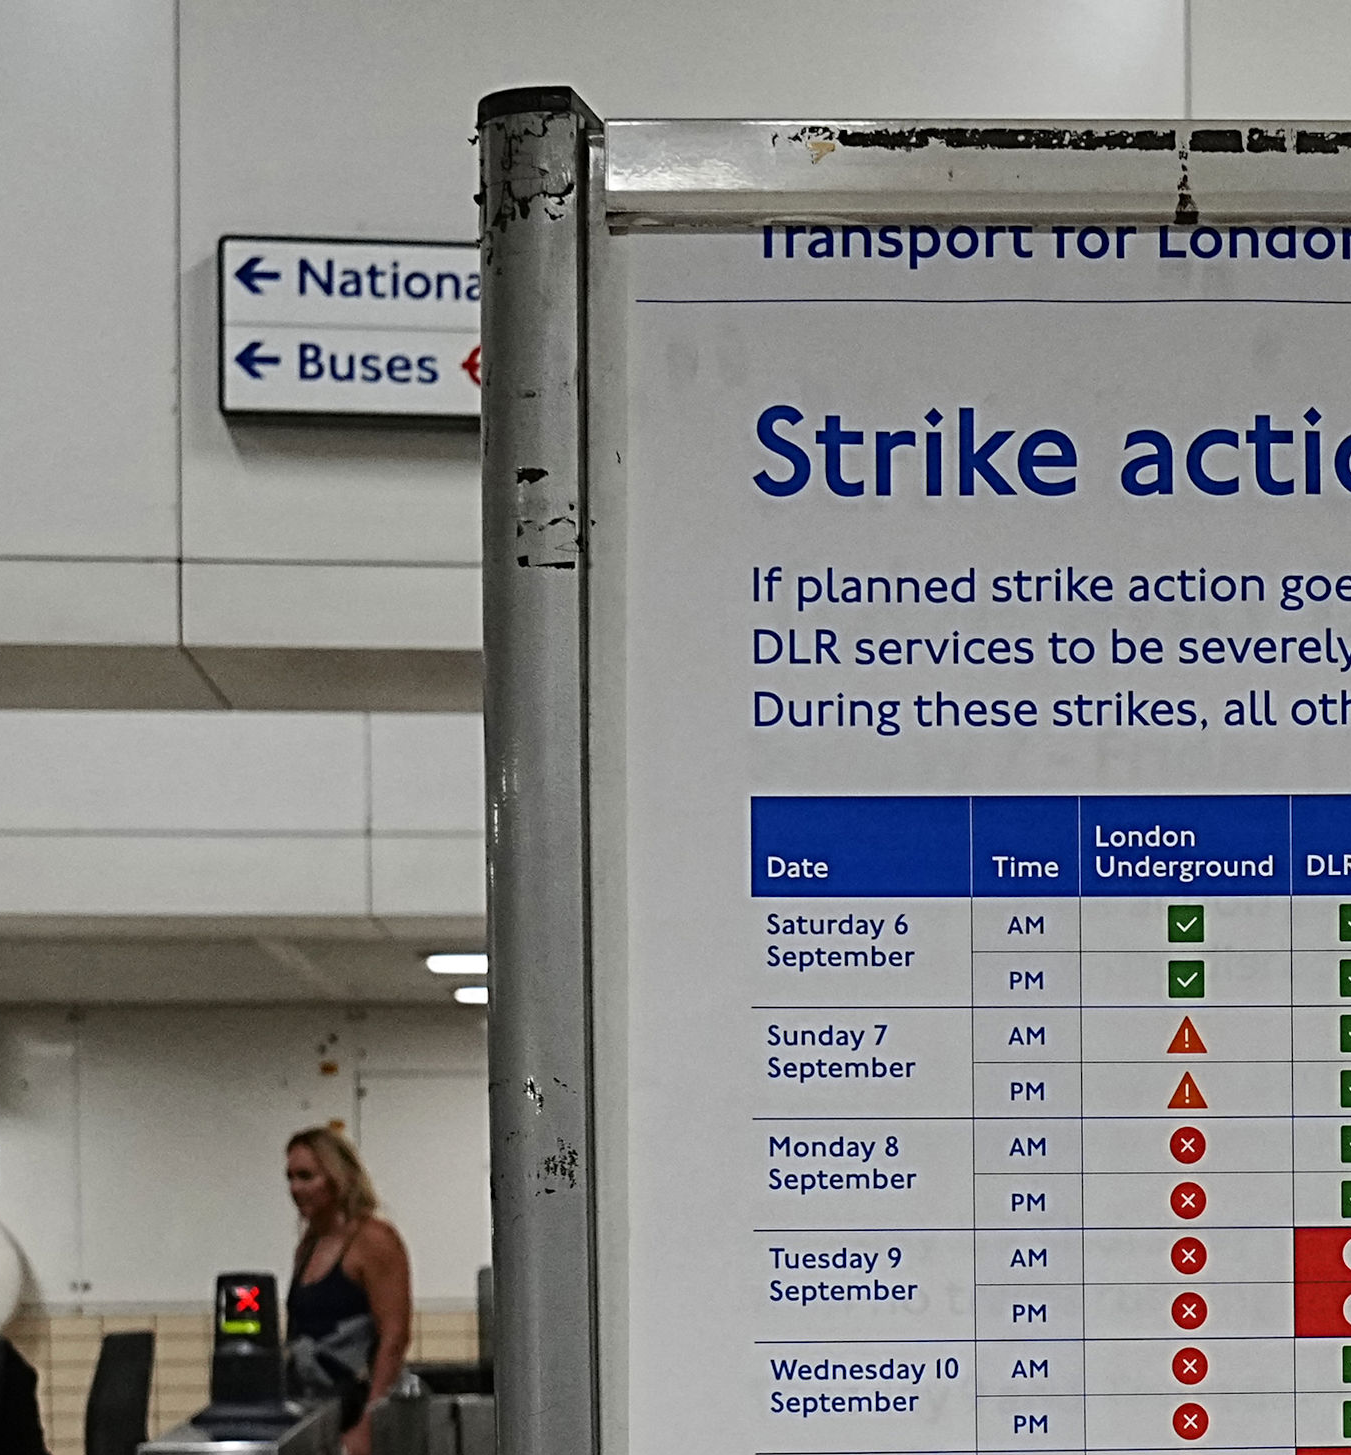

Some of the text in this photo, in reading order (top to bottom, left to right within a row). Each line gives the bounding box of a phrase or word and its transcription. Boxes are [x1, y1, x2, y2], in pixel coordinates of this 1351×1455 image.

[762, 226, 1033, 269] Transport
[1052, 226, 1138, 259] for
[297, 341, 440, 385] Buses
[752, 404, 1078, 498] Strike
[752, 565, 783, 603] If
[797, 566, 976, 613] planned
[991, 566, 1114, 603] strike
[1128, 566, 1265, 603] action
[753, 628, 842, 665] DLR
[854, 630, 1035, 666] services
[1047, 631, 1096, 665] to
[1111, 627, 1164, 665] be
[753, 690, 901, 737] During
[913, 690, 1038, 728] these
[1052, 690, 1208, 732] strikes,
[1224, 689, 1278, 727] all
[1095, 825, 1195, 848] London
[767, 856, 829, 878] Date
[991, 856, 1059, 878] Time
[1095, 854, 1273, 883] Underground
[766, 912, 909, 941] Saturday 6
[766, 944, 916, 973] September
[766, 1024, 888, 1052] Sunday 7
[767, 1056, 917, 1084] September
[769, 1135, 900, 1163] Monday 8
[768, 1167, 918, 1196] September
[768, 1246, 902, 1275] Tuesday 9
[769, 1278, 919, 1307] September
[769, 1357, 959, 1386] Wednesday 10
[770, 1390, 920, 1419] September
